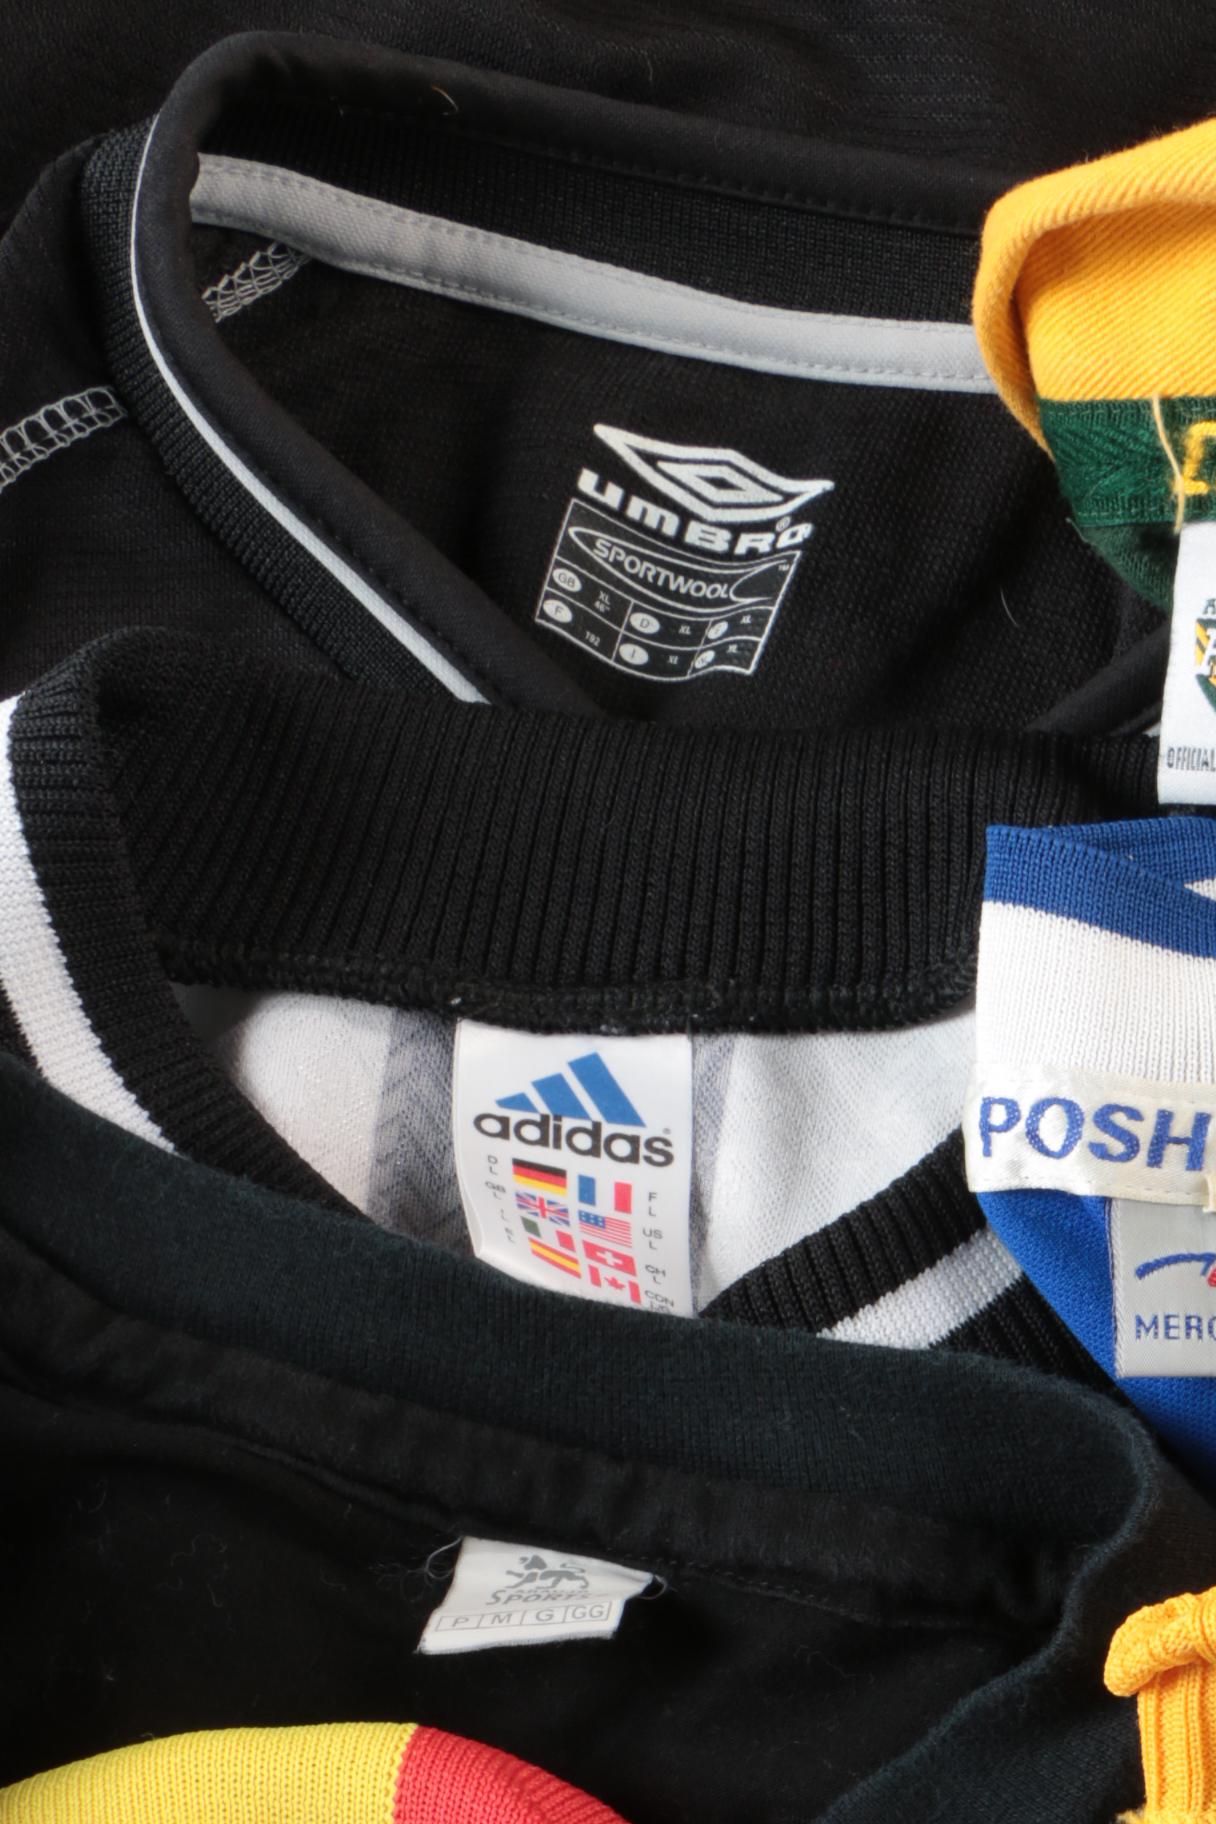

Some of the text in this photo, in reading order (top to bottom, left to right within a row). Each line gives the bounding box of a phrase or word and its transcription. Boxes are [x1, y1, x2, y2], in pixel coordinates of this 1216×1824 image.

[594, 538, 731, 601] SPORTWOOL
[558, 573, 577, 589] GB
[599, 592, 611, 605] XL
[679, 624, 692, 635] XL
[1166, 746, 1215, 772] OFFICIAL
[473, 1113, 674, 1167] adidas
[978, 1097, 1213, 1171] POSH
[648, 1192, 657, 1202] F
[643, 1228, 663, 1239] US
[452, 1604, 604, 1628] P M G GG
